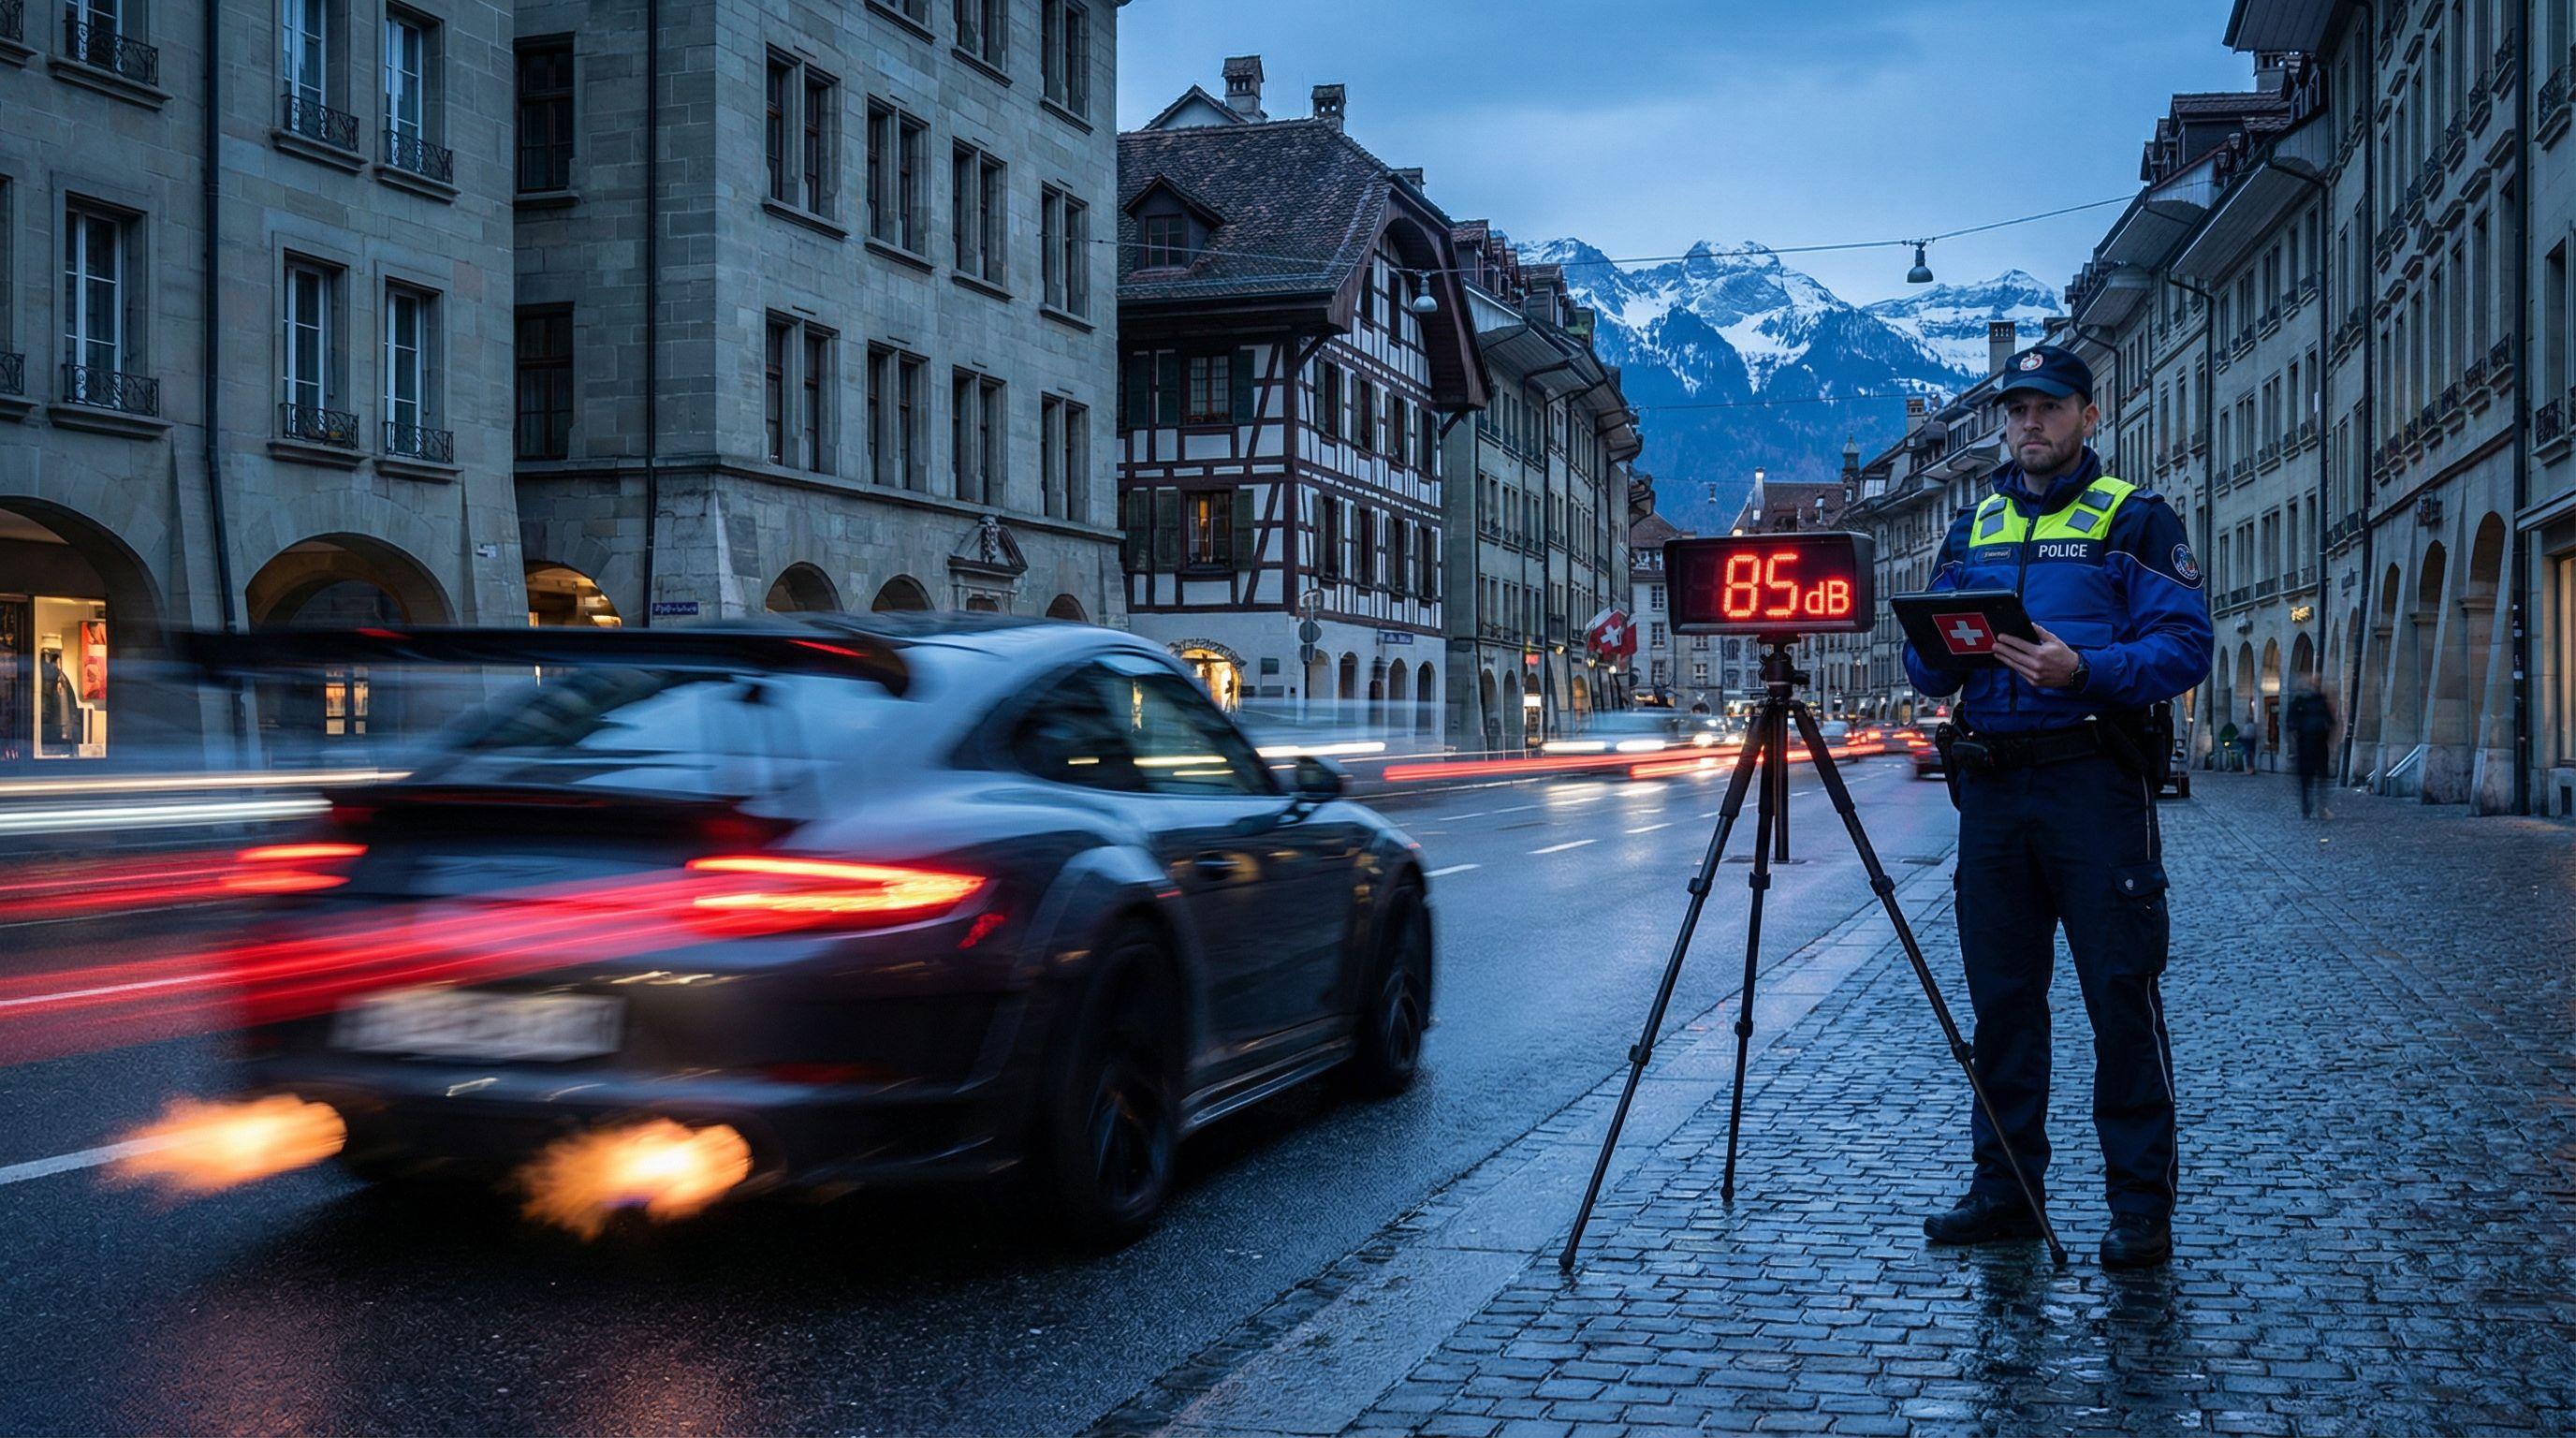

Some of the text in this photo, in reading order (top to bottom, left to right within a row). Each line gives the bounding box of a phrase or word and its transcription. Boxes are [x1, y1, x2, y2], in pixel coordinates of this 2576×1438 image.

[2038, 544, 2087, 558] POLICE
[1723, 553, 1850, 617] 85 dB
